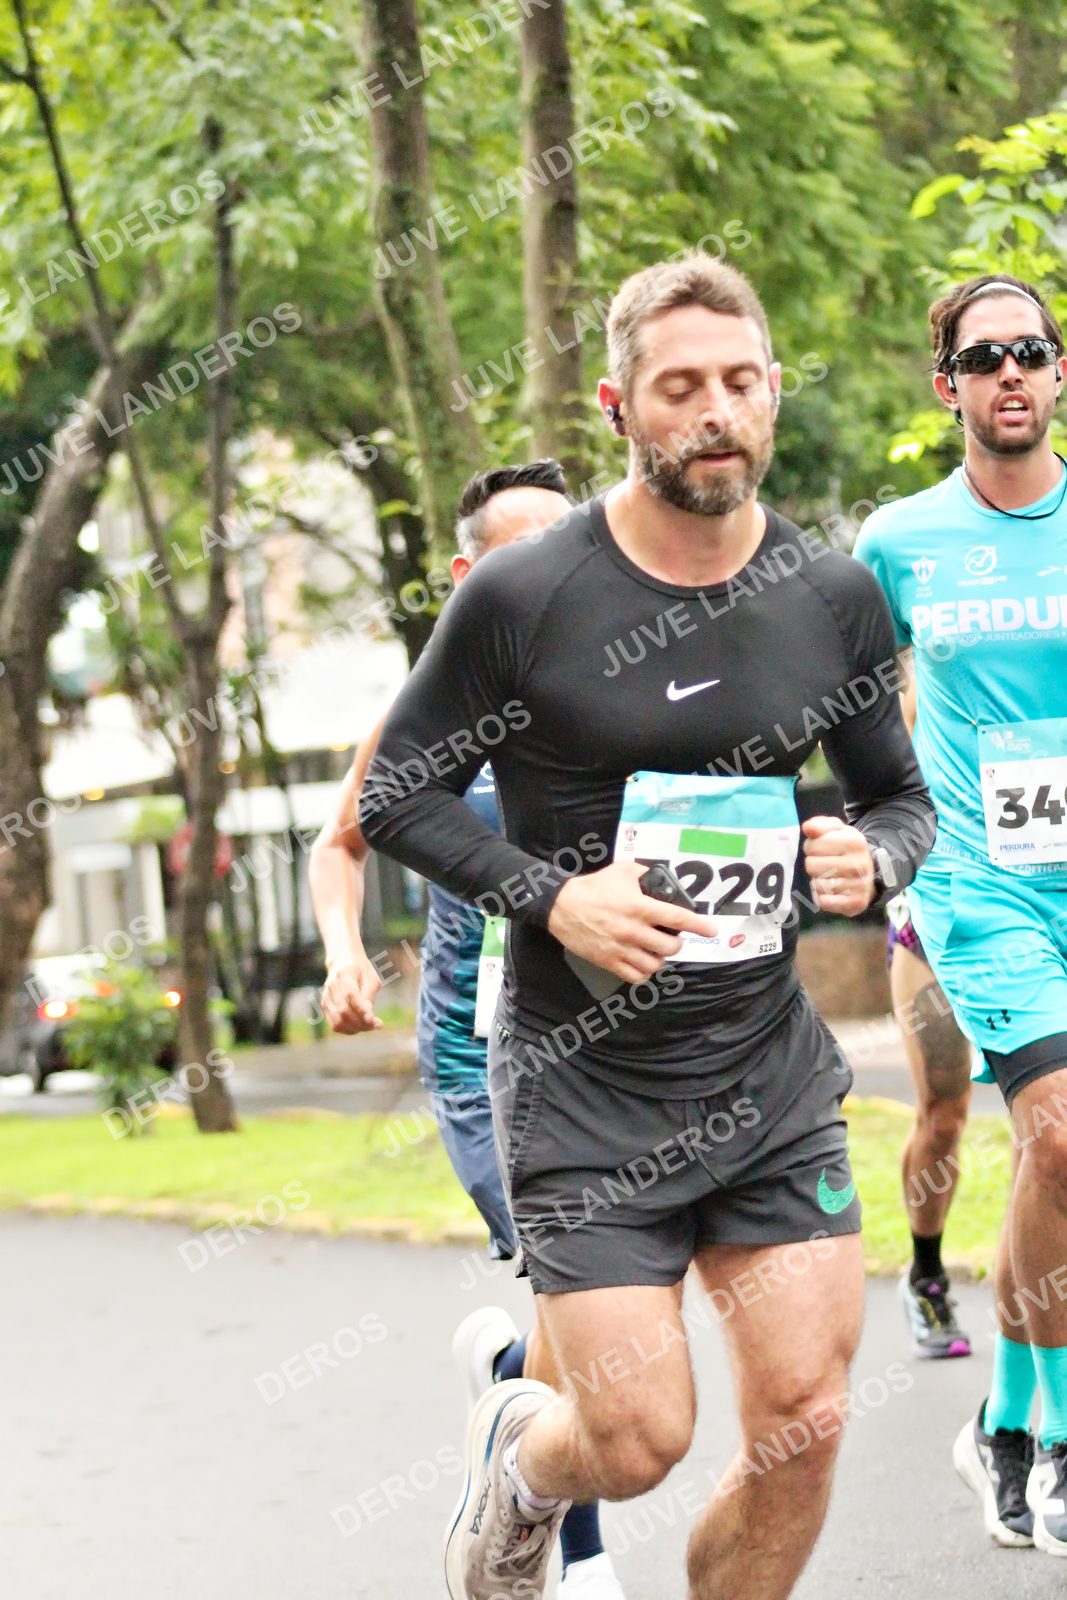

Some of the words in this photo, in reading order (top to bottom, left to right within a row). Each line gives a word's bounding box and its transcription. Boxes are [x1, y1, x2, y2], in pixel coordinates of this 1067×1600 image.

[911, 594, 1067, 640] PERDU
[995, 784, 1067, 830] 34
[634, 857, 785, 917] 229
[758, 942, 777, 954] 5229
